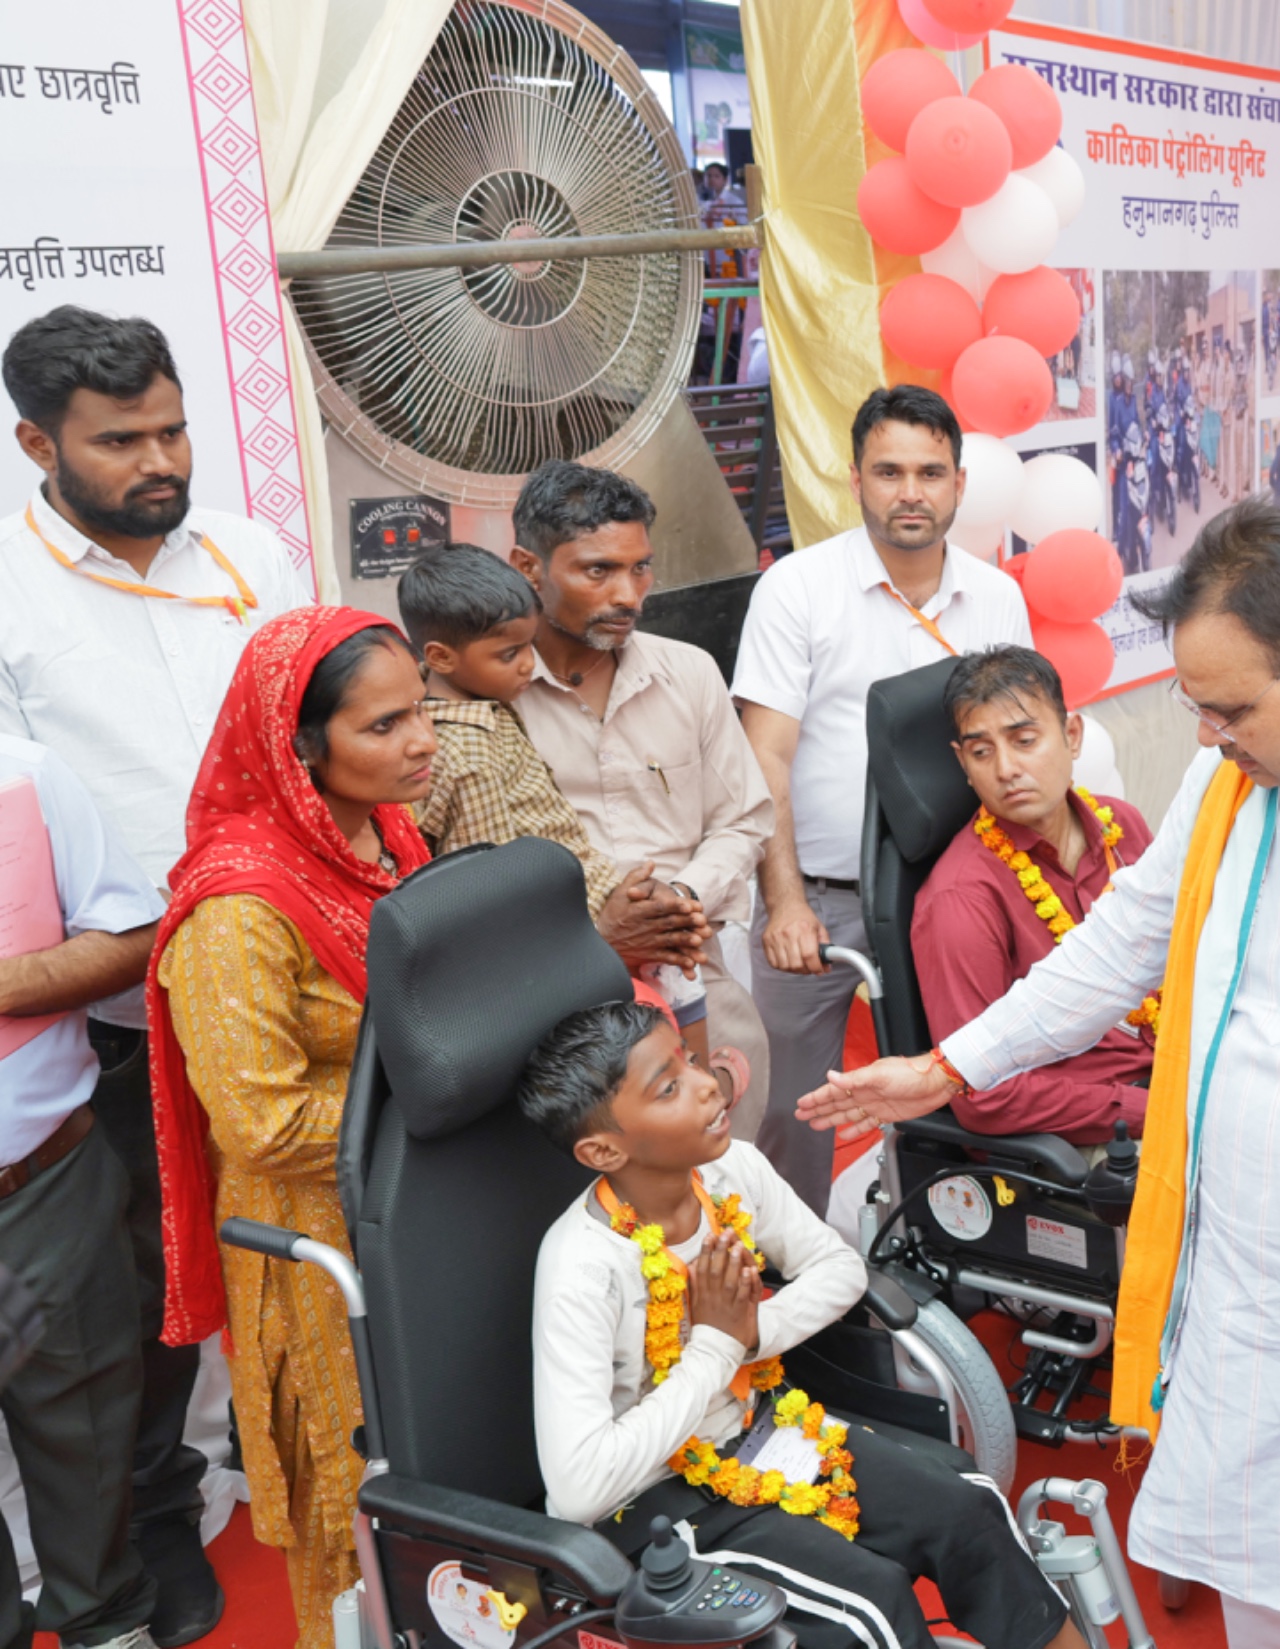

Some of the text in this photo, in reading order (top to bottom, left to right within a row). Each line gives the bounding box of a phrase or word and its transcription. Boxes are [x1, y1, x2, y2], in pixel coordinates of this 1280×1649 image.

[0, 61, 141, 116] ए छात्रवृत्ति
[1001, 51, 1119, 101] जस्थान
[1123, 73, 1200, 113] सरकार
[1202, 86, 1244, 119] द्वारा
[1085, 122, 1267, 188] कालिका पेट्रोलिंग यूनिट
[1121, 189, 1240, 241] हनुमानगढ़ पुलिस
[67, 245, 165, 279] उपलब्ध
[358, 502, 404, 533] COOLING
